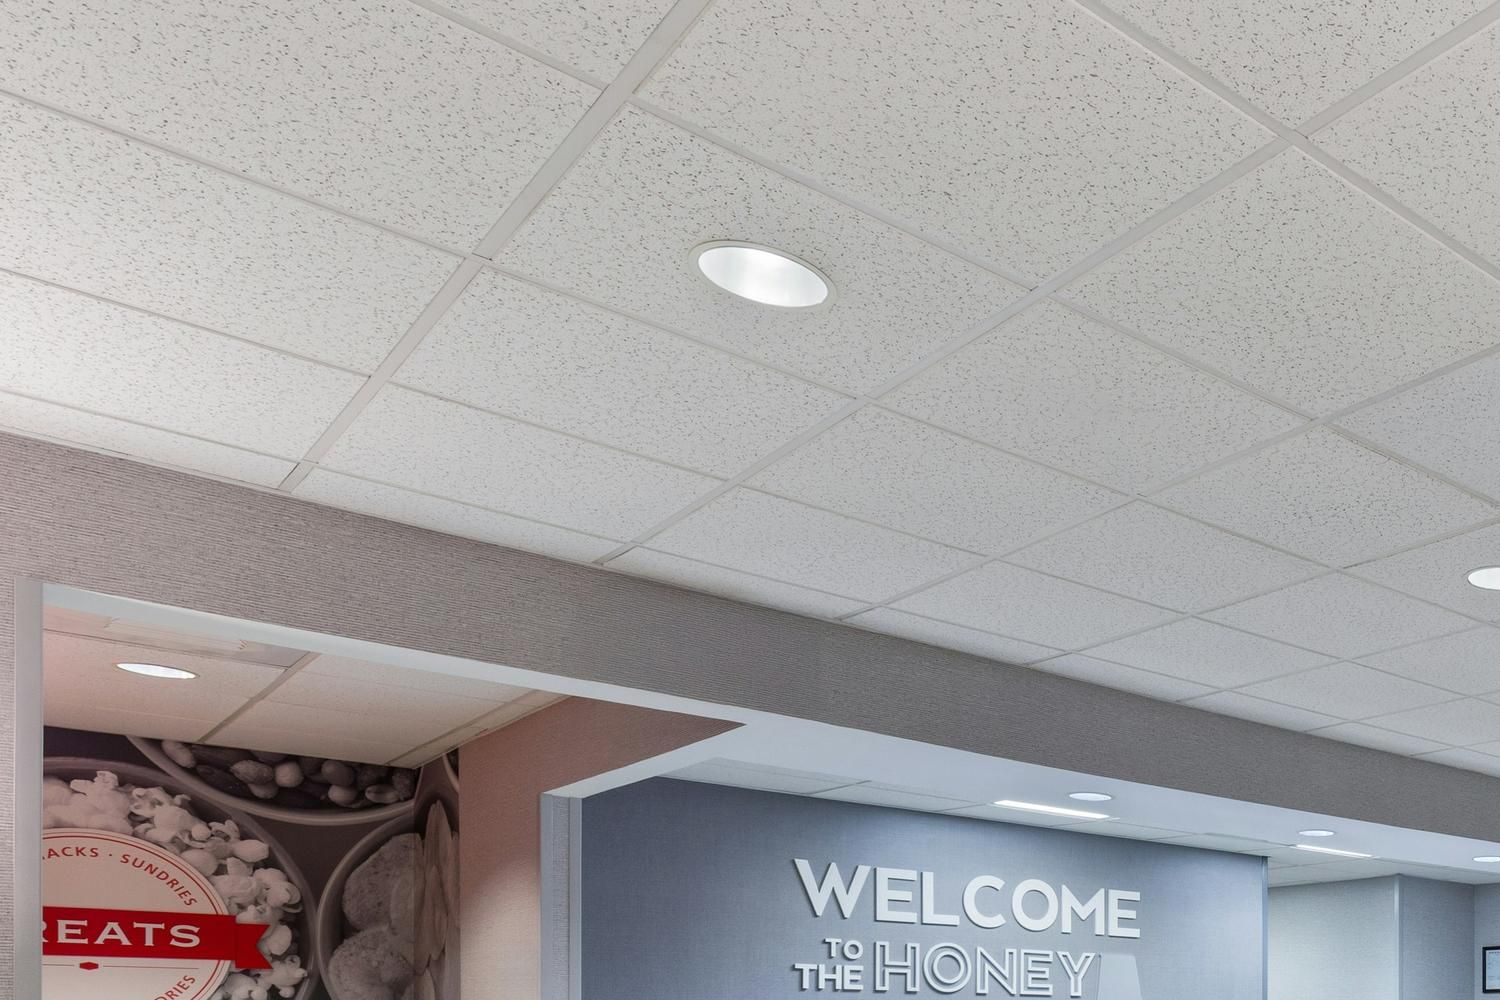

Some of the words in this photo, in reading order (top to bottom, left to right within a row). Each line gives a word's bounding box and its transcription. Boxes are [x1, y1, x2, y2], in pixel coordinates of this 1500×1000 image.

[43, 847, 99, 861] ACKS
[120, 854, 198, 907] SUNDRIES
[793, 858, 1141, 938] WELCOME
[793, 963, 864, 991] THE
[874, 941, 1096, 997] HONEY
[825, 938, 864, 960] TO
